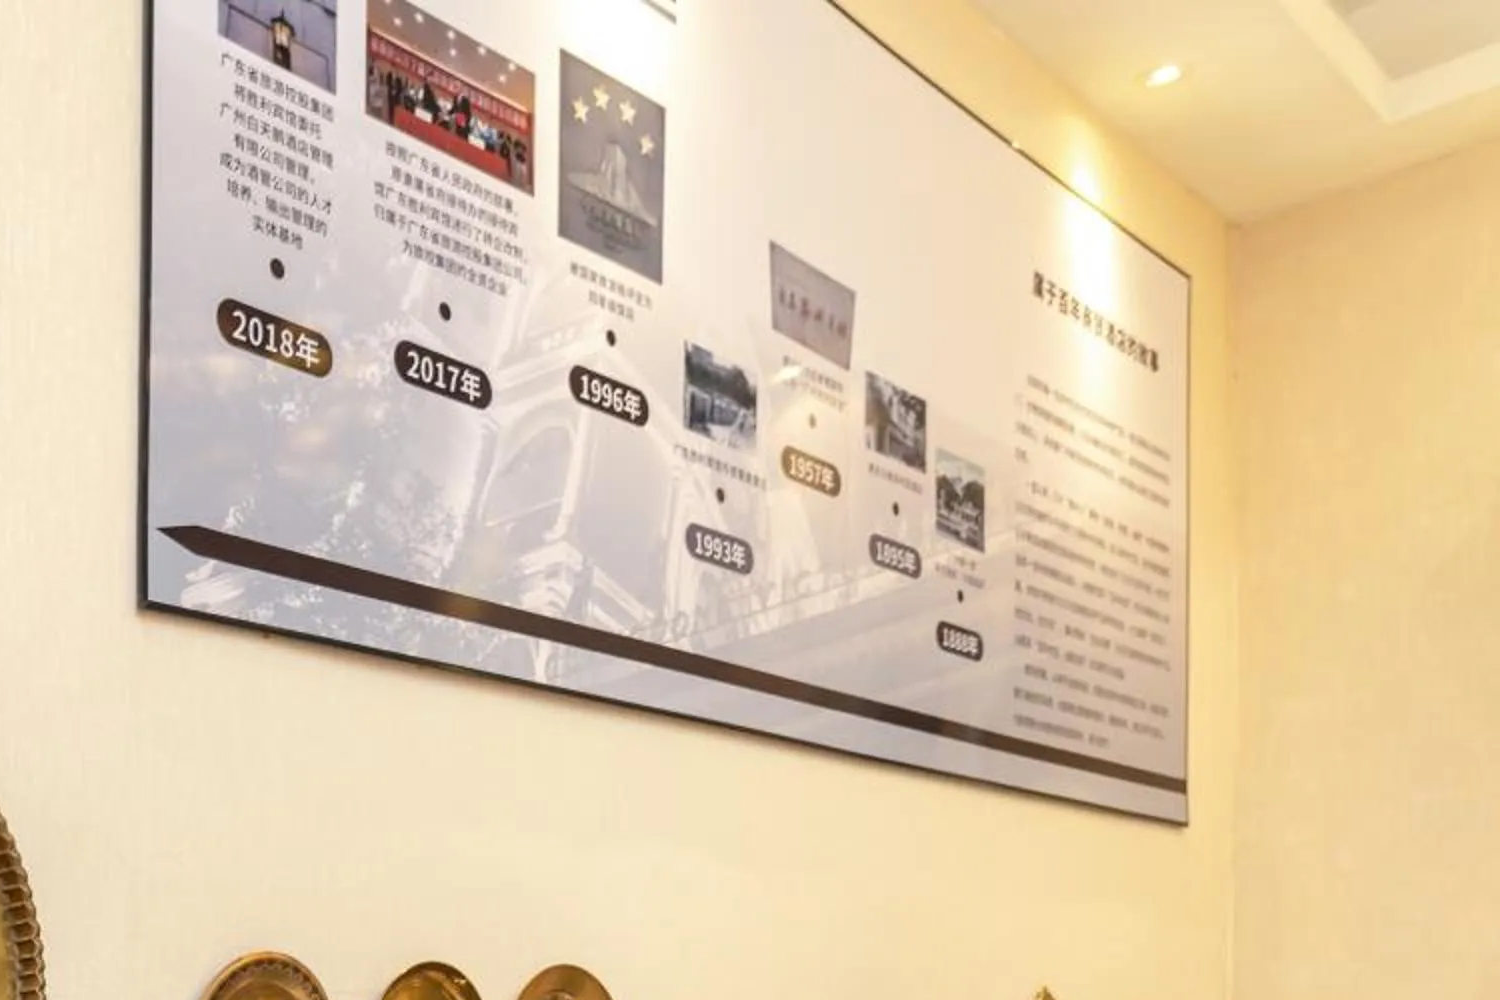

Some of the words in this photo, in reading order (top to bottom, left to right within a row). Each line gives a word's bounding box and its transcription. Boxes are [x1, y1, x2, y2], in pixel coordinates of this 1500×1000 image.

[231, 311, 320, 369] 2018年
[405, 351, 482, 403] 2017年
[580, 374, 642, 420] 1996年
[789, 454, 835, 491] 1957年
[695, 532, 746, 569] 1993年
